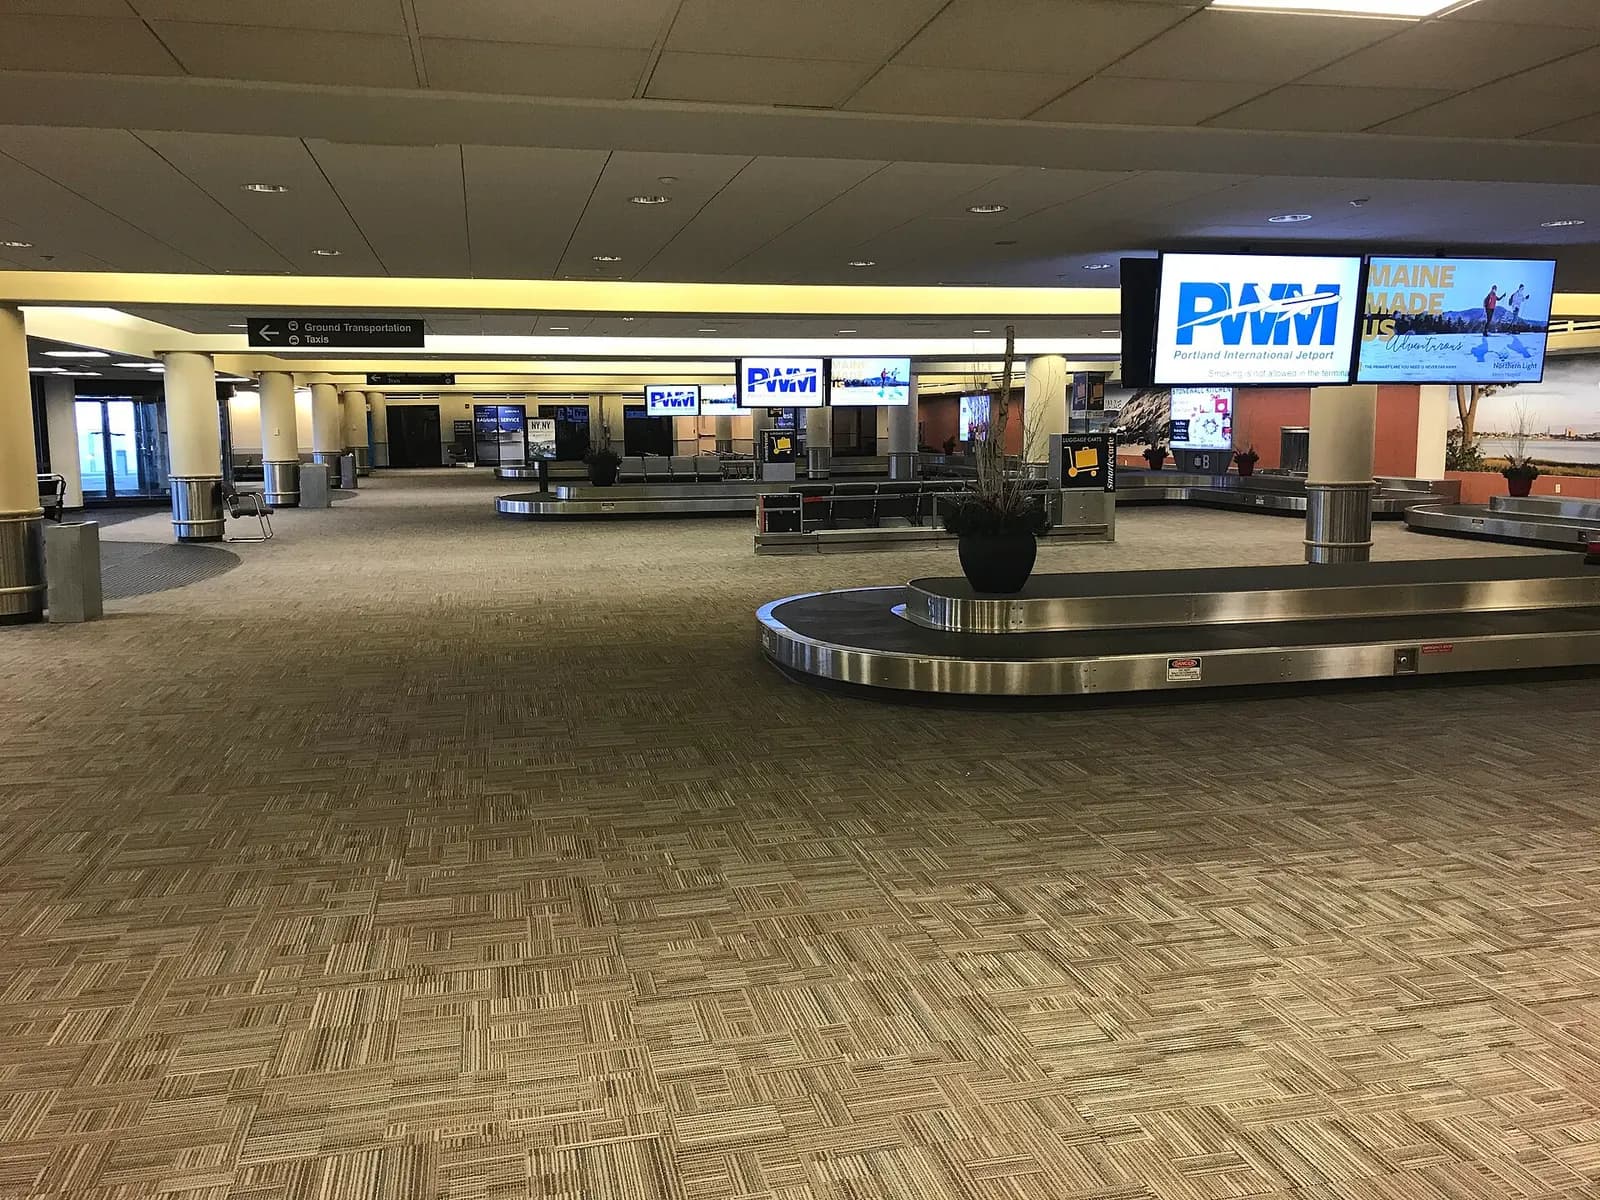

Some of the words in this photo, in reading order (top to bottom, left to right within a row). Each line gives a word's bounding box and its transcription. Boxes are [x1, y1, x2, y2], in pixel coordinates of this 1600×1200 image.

[1368, 264, 1456, 288] MAINE
[1365, 292, 1444, 315] MADE
[1176, 282, 1340, 345] PWM
[304, 323, 341, 332] Ground
[343, 323, 412, 334] Transportation
[1362, 319, 1396, 342] US
[305, 335, 329, 344] Taxis
[1173, 350, 1220, 360] Portland
[1224, 351, 1292, 361] International
[1296, 351, 1334, 361] Jetport
[1208, 369, 1242, 378] Smoking
[1254, 369, 1266, 377] not
[1269, 369, 1297, 377] allowed
[1307, 369, 1319, 377] the
[1493, 361, 1521, 369] Northern
[1522, 361, 1537, 370] Light
[748, 368, 816, 392] PWM
[651, 391, 695, 407] PWM
[1106, 436, 1115, 490] smartecarte
[1202, 454, 1210, 469] B
